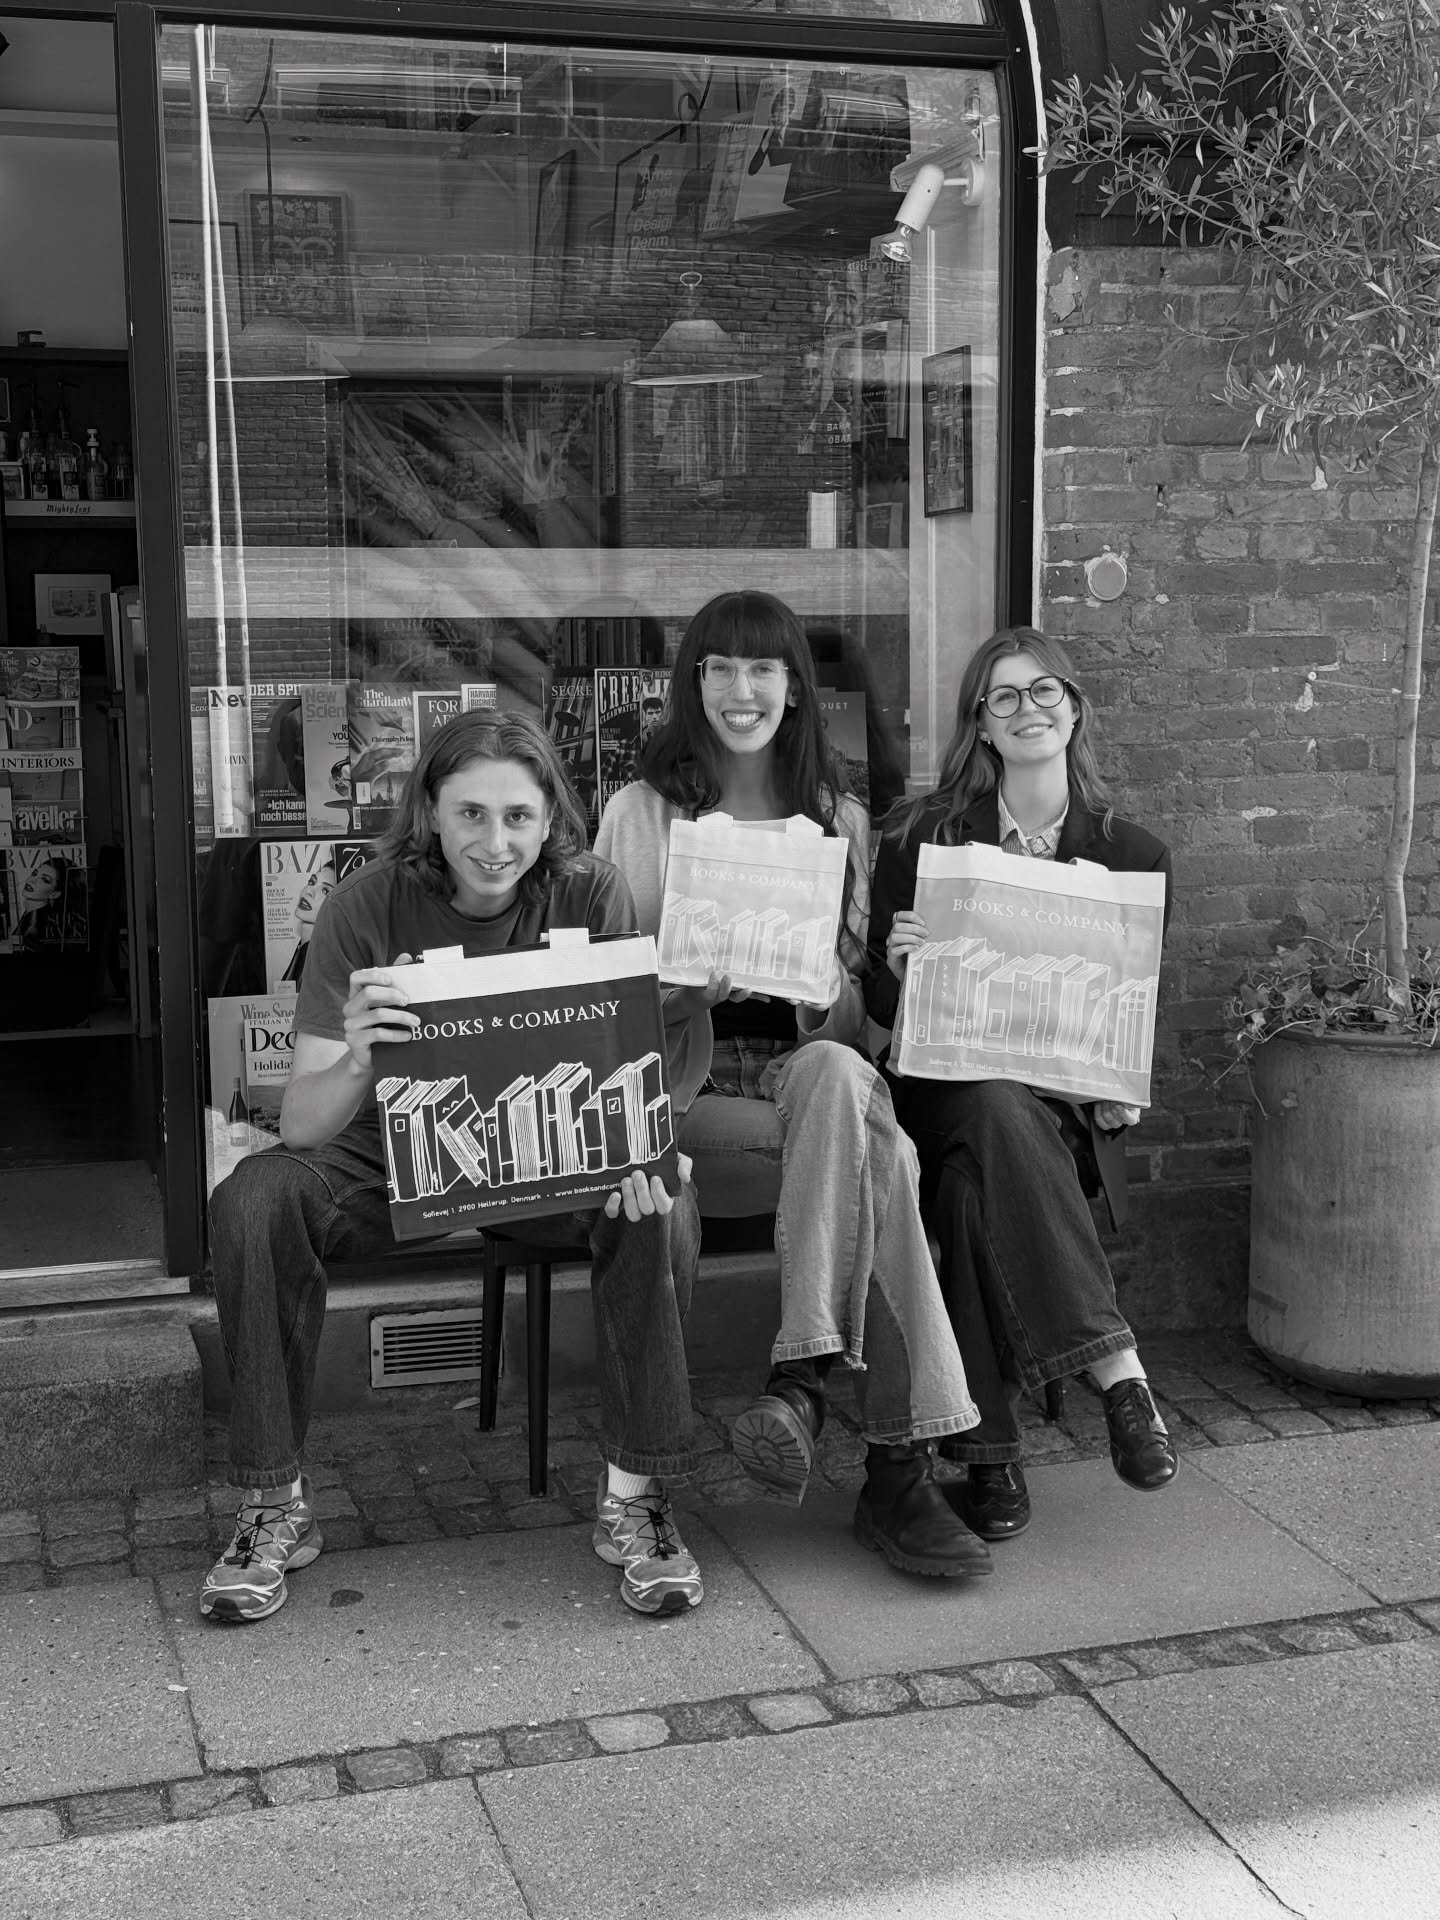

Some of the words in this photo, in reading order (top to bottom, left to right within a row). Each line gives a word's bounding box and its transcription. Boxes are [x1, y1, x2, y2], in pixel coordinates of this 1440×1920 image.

[633, 217, 673, 233] Desig
[248, 683, 276, 697] DER
[278, 683, 302, 697] SPI
[305, 687, 337, 704] New
[363, 688, 385, 701] The
[551, 684, 594, 698] SECRE
[306, 703, 346, 719] Scien
[427, 699, 462, 714] FOR
[1, 757, 75, 769] INTERIORS
[260, 811, 282, 822] noch
[690, 866, 736, 882] BOOKS
[951, 897, 1015, 919] BOOKS
[1019, 907, 1030, 918] &
[1034, 909, 1129, 937] COMPANY
[240, 1002, 271, 1020] Wine
[411, 1018, 485, 1042] BOOKS
[491, 1015, 504, 1029] &
[508, 1000, 621, 1031] COMPANY
[254, 1059, 294, 1072] Holida
[458, 1203, 476, 1213] 2900
[510, 1193, 542, 1204] Denmark
